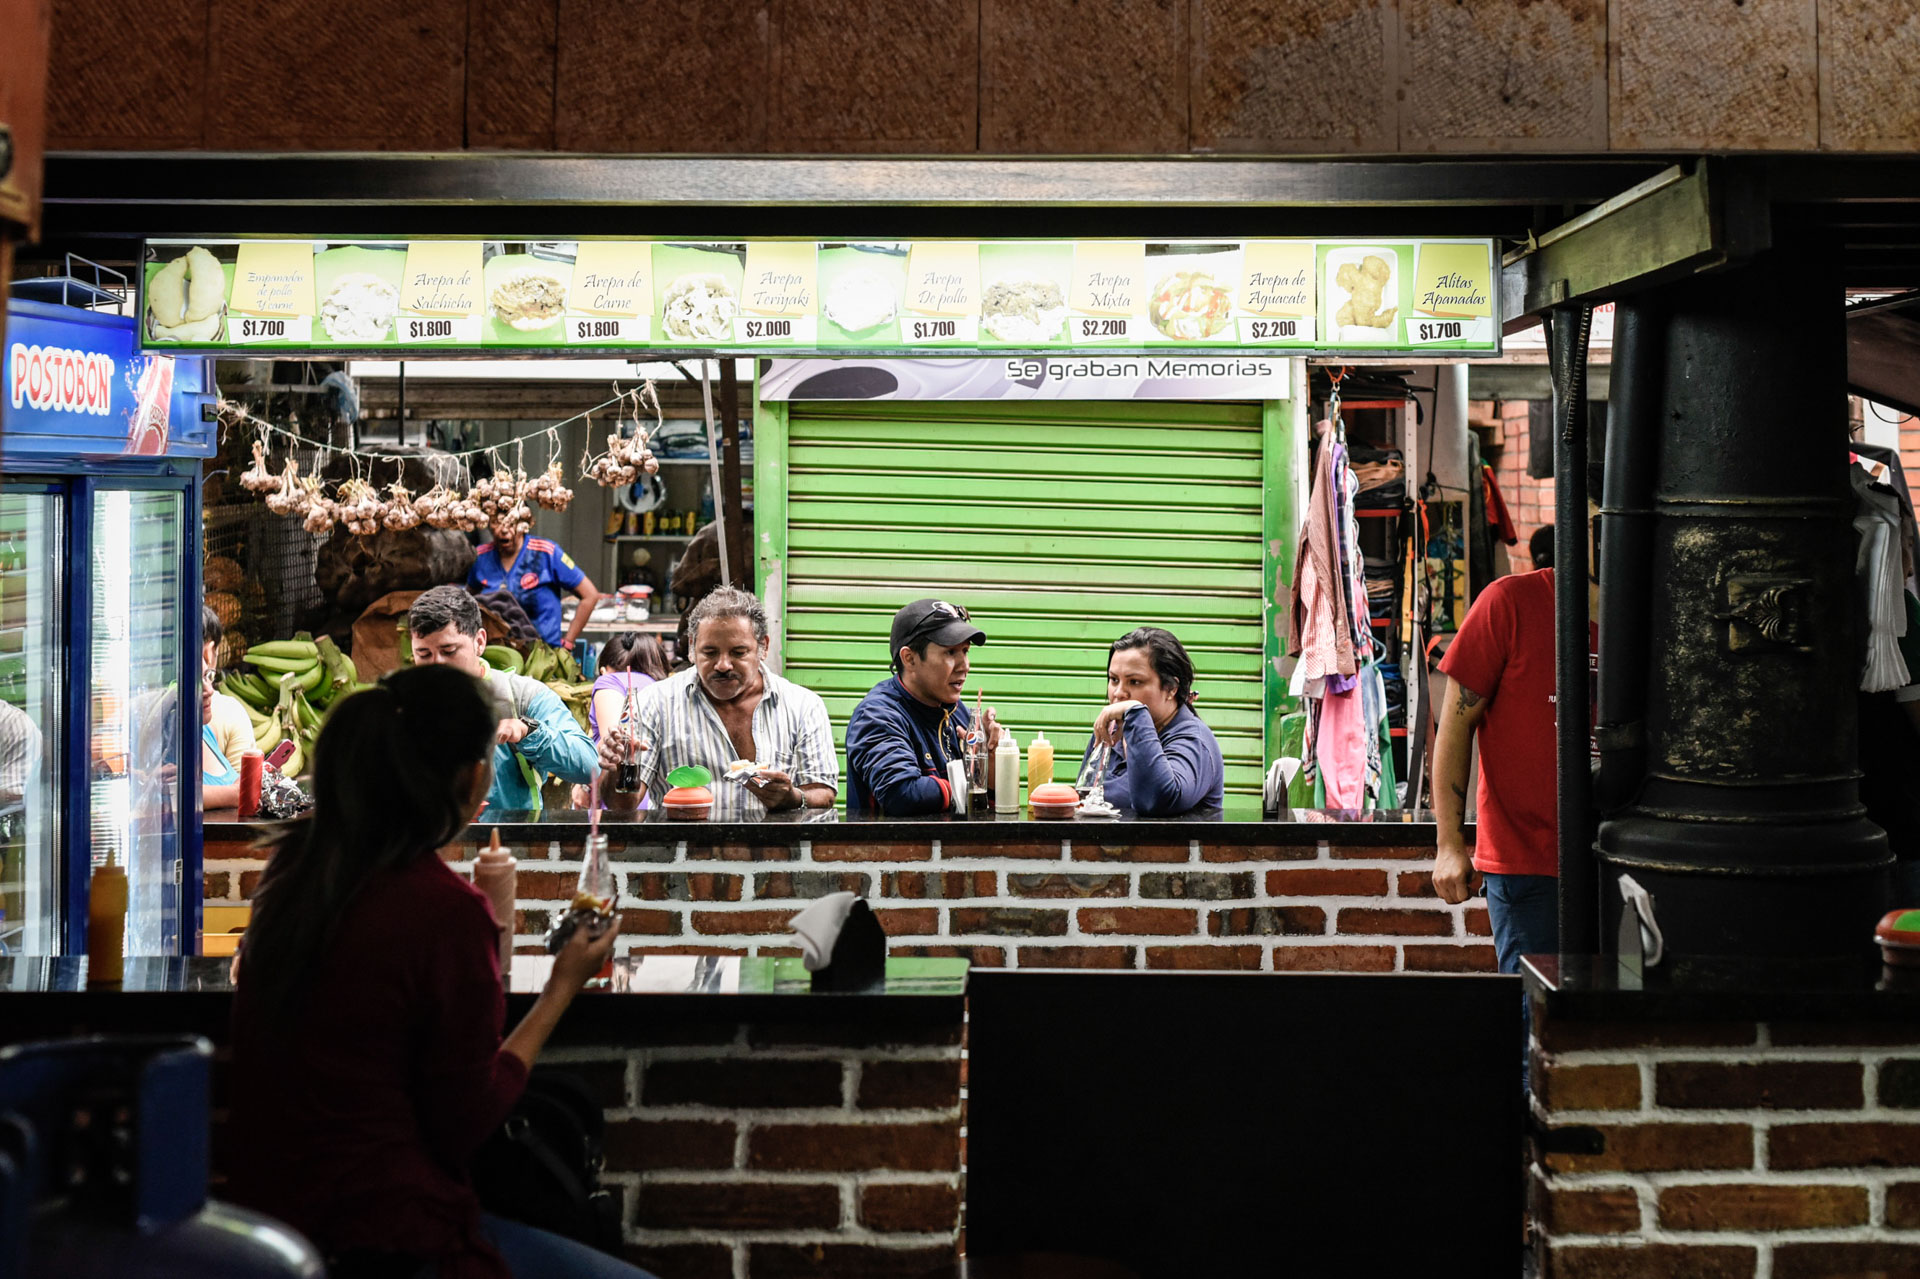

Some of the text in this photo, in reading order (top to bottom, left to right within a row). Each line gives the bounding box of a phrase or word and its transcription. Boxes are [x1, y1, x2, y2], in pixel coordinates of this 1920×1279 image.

[248, 270, 304, 286] Empanadas
[414, 270, 471, 292] Arepa de
[584, 270, 642, 296] Arepa de
[760, 271, 802, 292] Arepa
[923, 271, 962, 292] Arepa
[1088, 272, 1130, 294] Arepa
[1250, 269, 1306, 293] Arepa de
[1436, 272, 1473, 289] Alitas
[268, 284, 292, 301] pollo
[412, 293, 472, 310] Salchicha
[593, 294, 631, 309] Carne
[753, 288, 810, 313] Teriyaki
[918, 287, 967, 311] De pollo
[1089, 292, 1131, 309] Mixta
[1248, 290, 1307, 313] Aguacate
[1422, 288, 1487, 312] Apanadas
[268, 302, 293, 310] carne
[243, 319, 285, 337] $1.700
[410, 320, 451, 338] $1.800
[578, 321, 619, 338] $1.800
[746, 320, 791, 338] $2.000
[914, 320, 955, 339] $1.700
[1082, 319, 1127, 337] $2.200
[1252, 320, 1296, 339] $2.200
[1420, 322, 1462, 341] $1.700
[1008, 359, 1272, 380] Se graban Memorias
[13, 349, 110, 412] POSTOBON
